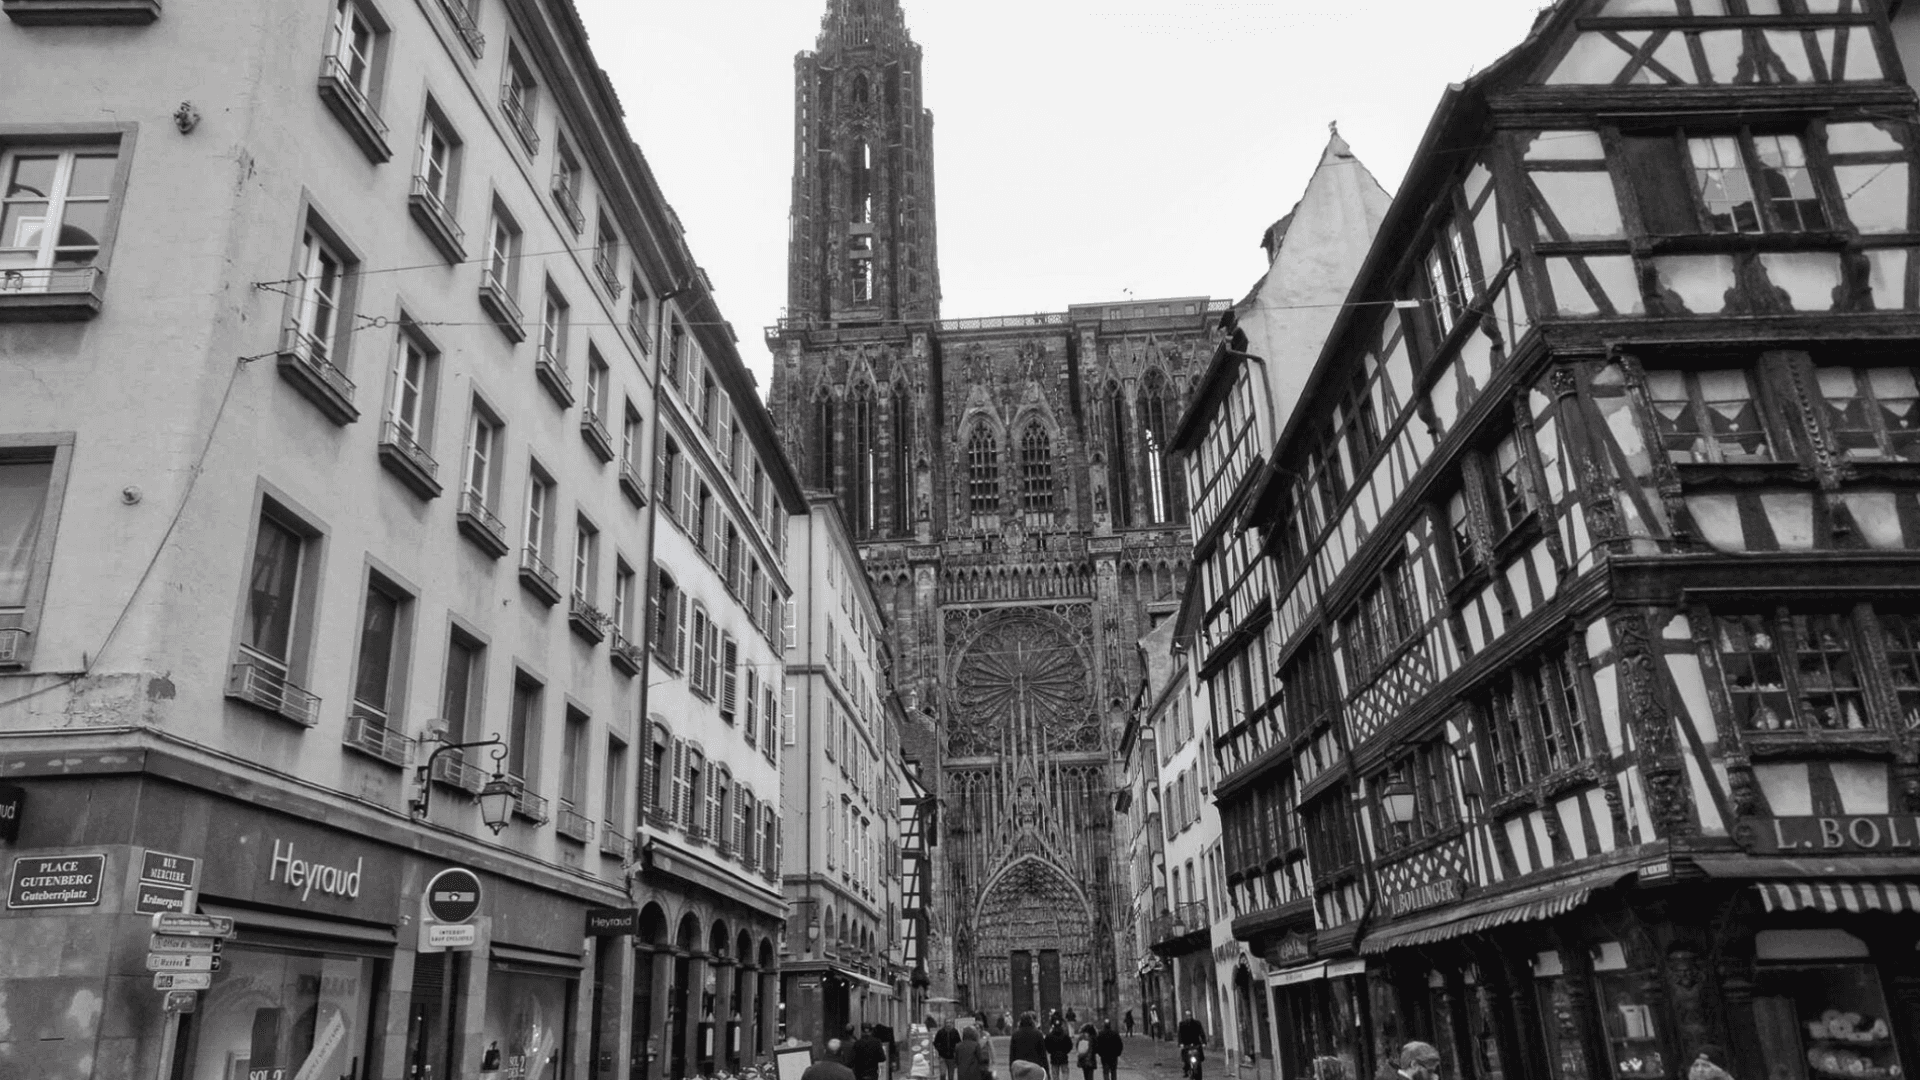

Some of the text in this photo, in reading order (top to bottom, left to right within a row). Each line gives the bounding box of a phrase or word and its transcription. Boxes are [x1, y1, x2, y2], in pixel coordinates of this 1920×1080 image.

[0, 800, 17, 819] ud
[39, 861, 79, 873] PLACE
[163, 857, 177, 869] RUE
[269, 838, 363, 902] Heyraud
[20, 874, 93, 888] GUTENBERG
[591, 916, 632, 929] Heyraud
